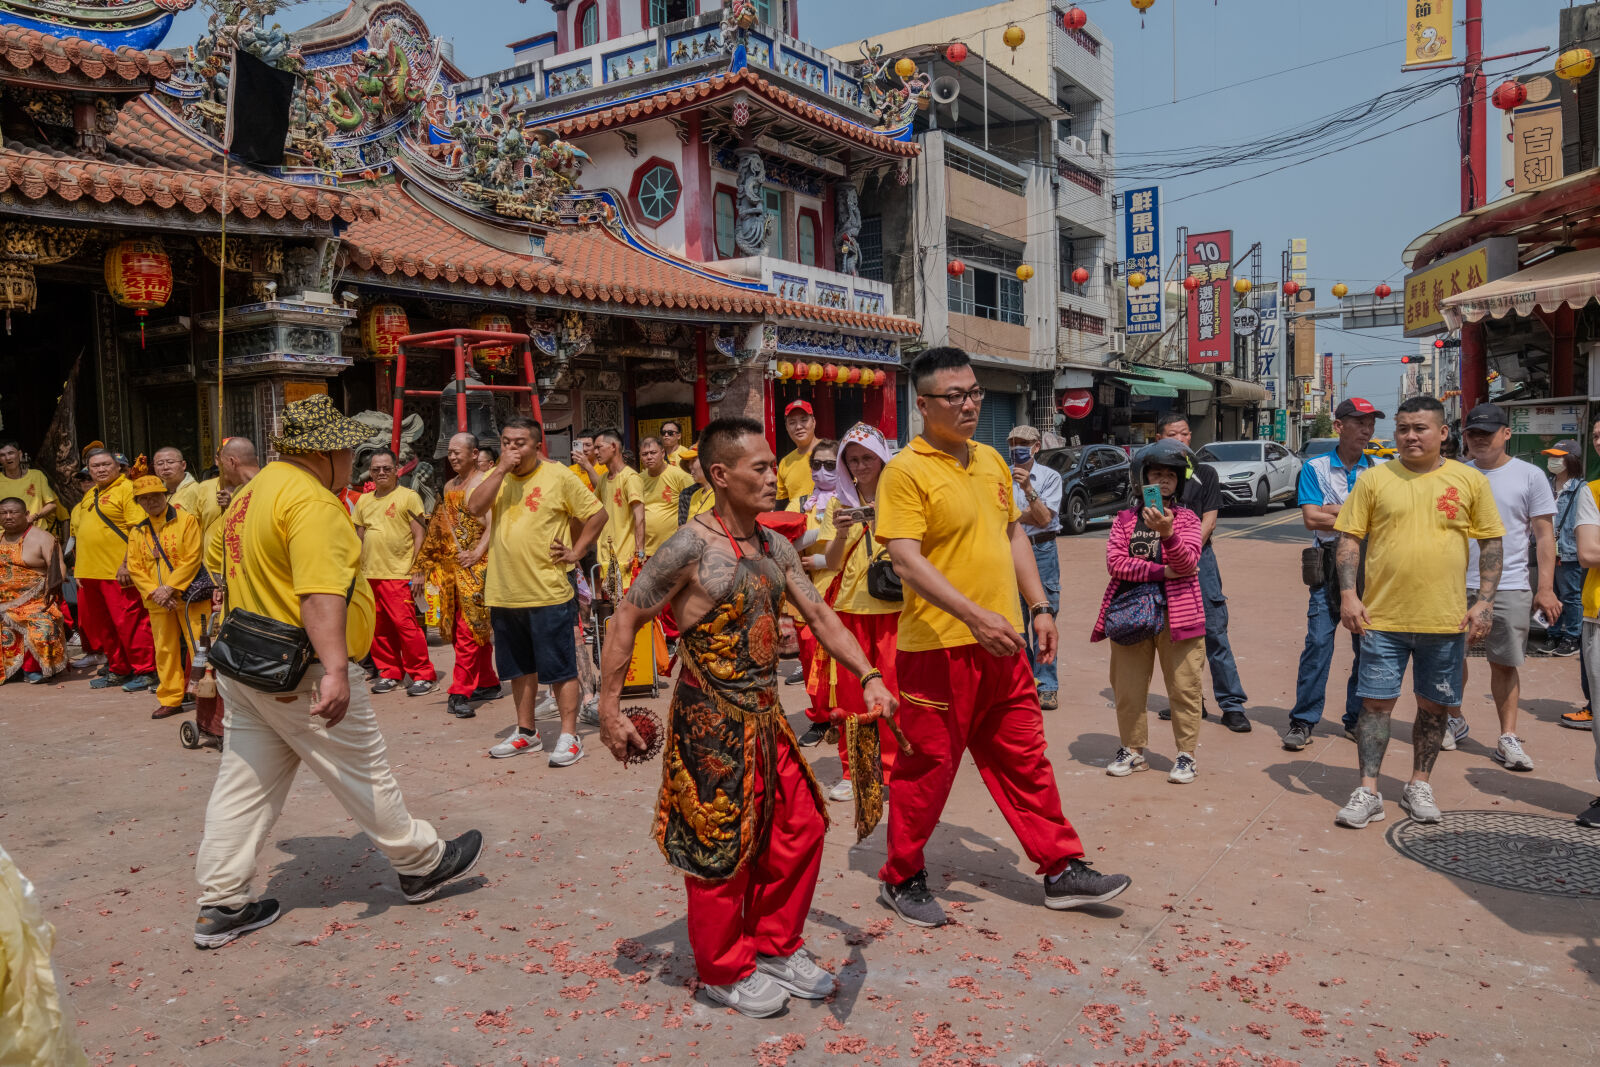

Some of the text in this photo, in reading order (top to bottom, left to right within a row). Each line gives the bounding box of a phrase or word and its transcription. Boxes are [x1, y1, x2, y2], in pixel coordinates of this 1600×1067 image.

[1523, 127, 1553, 184] 吉利
[1130, 190, 1154, 254] 鮮果園
[1194, 242, 1220, 261] 10
